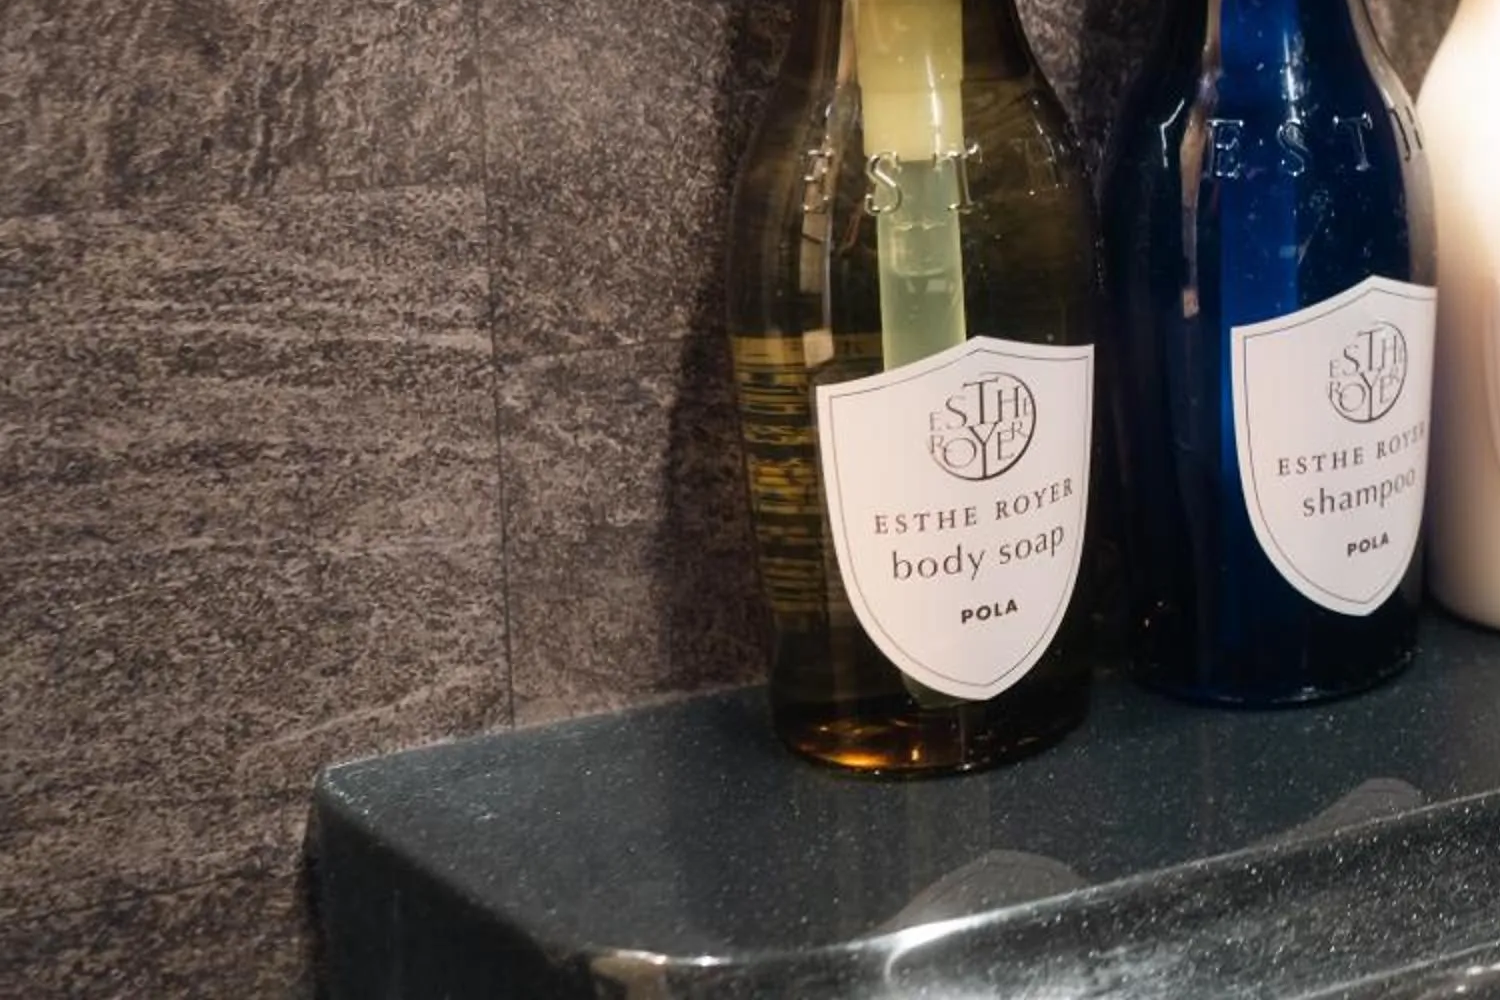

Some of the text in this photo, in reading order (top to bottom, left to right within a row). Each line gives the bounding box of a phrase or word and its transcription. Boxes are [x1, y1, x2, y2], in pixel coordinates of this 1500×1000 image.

[1277, 420, 1427, 477] ESTHE ROYER
[873, 477, 1074, 536] ESTHE ROYER
[1301, 468, 1417, 518] shampoo
[891, 524, 1065, 581] body soap
[1346, 532, 1391, 558] POLA
[960, 599, 1020, 625] POLA
